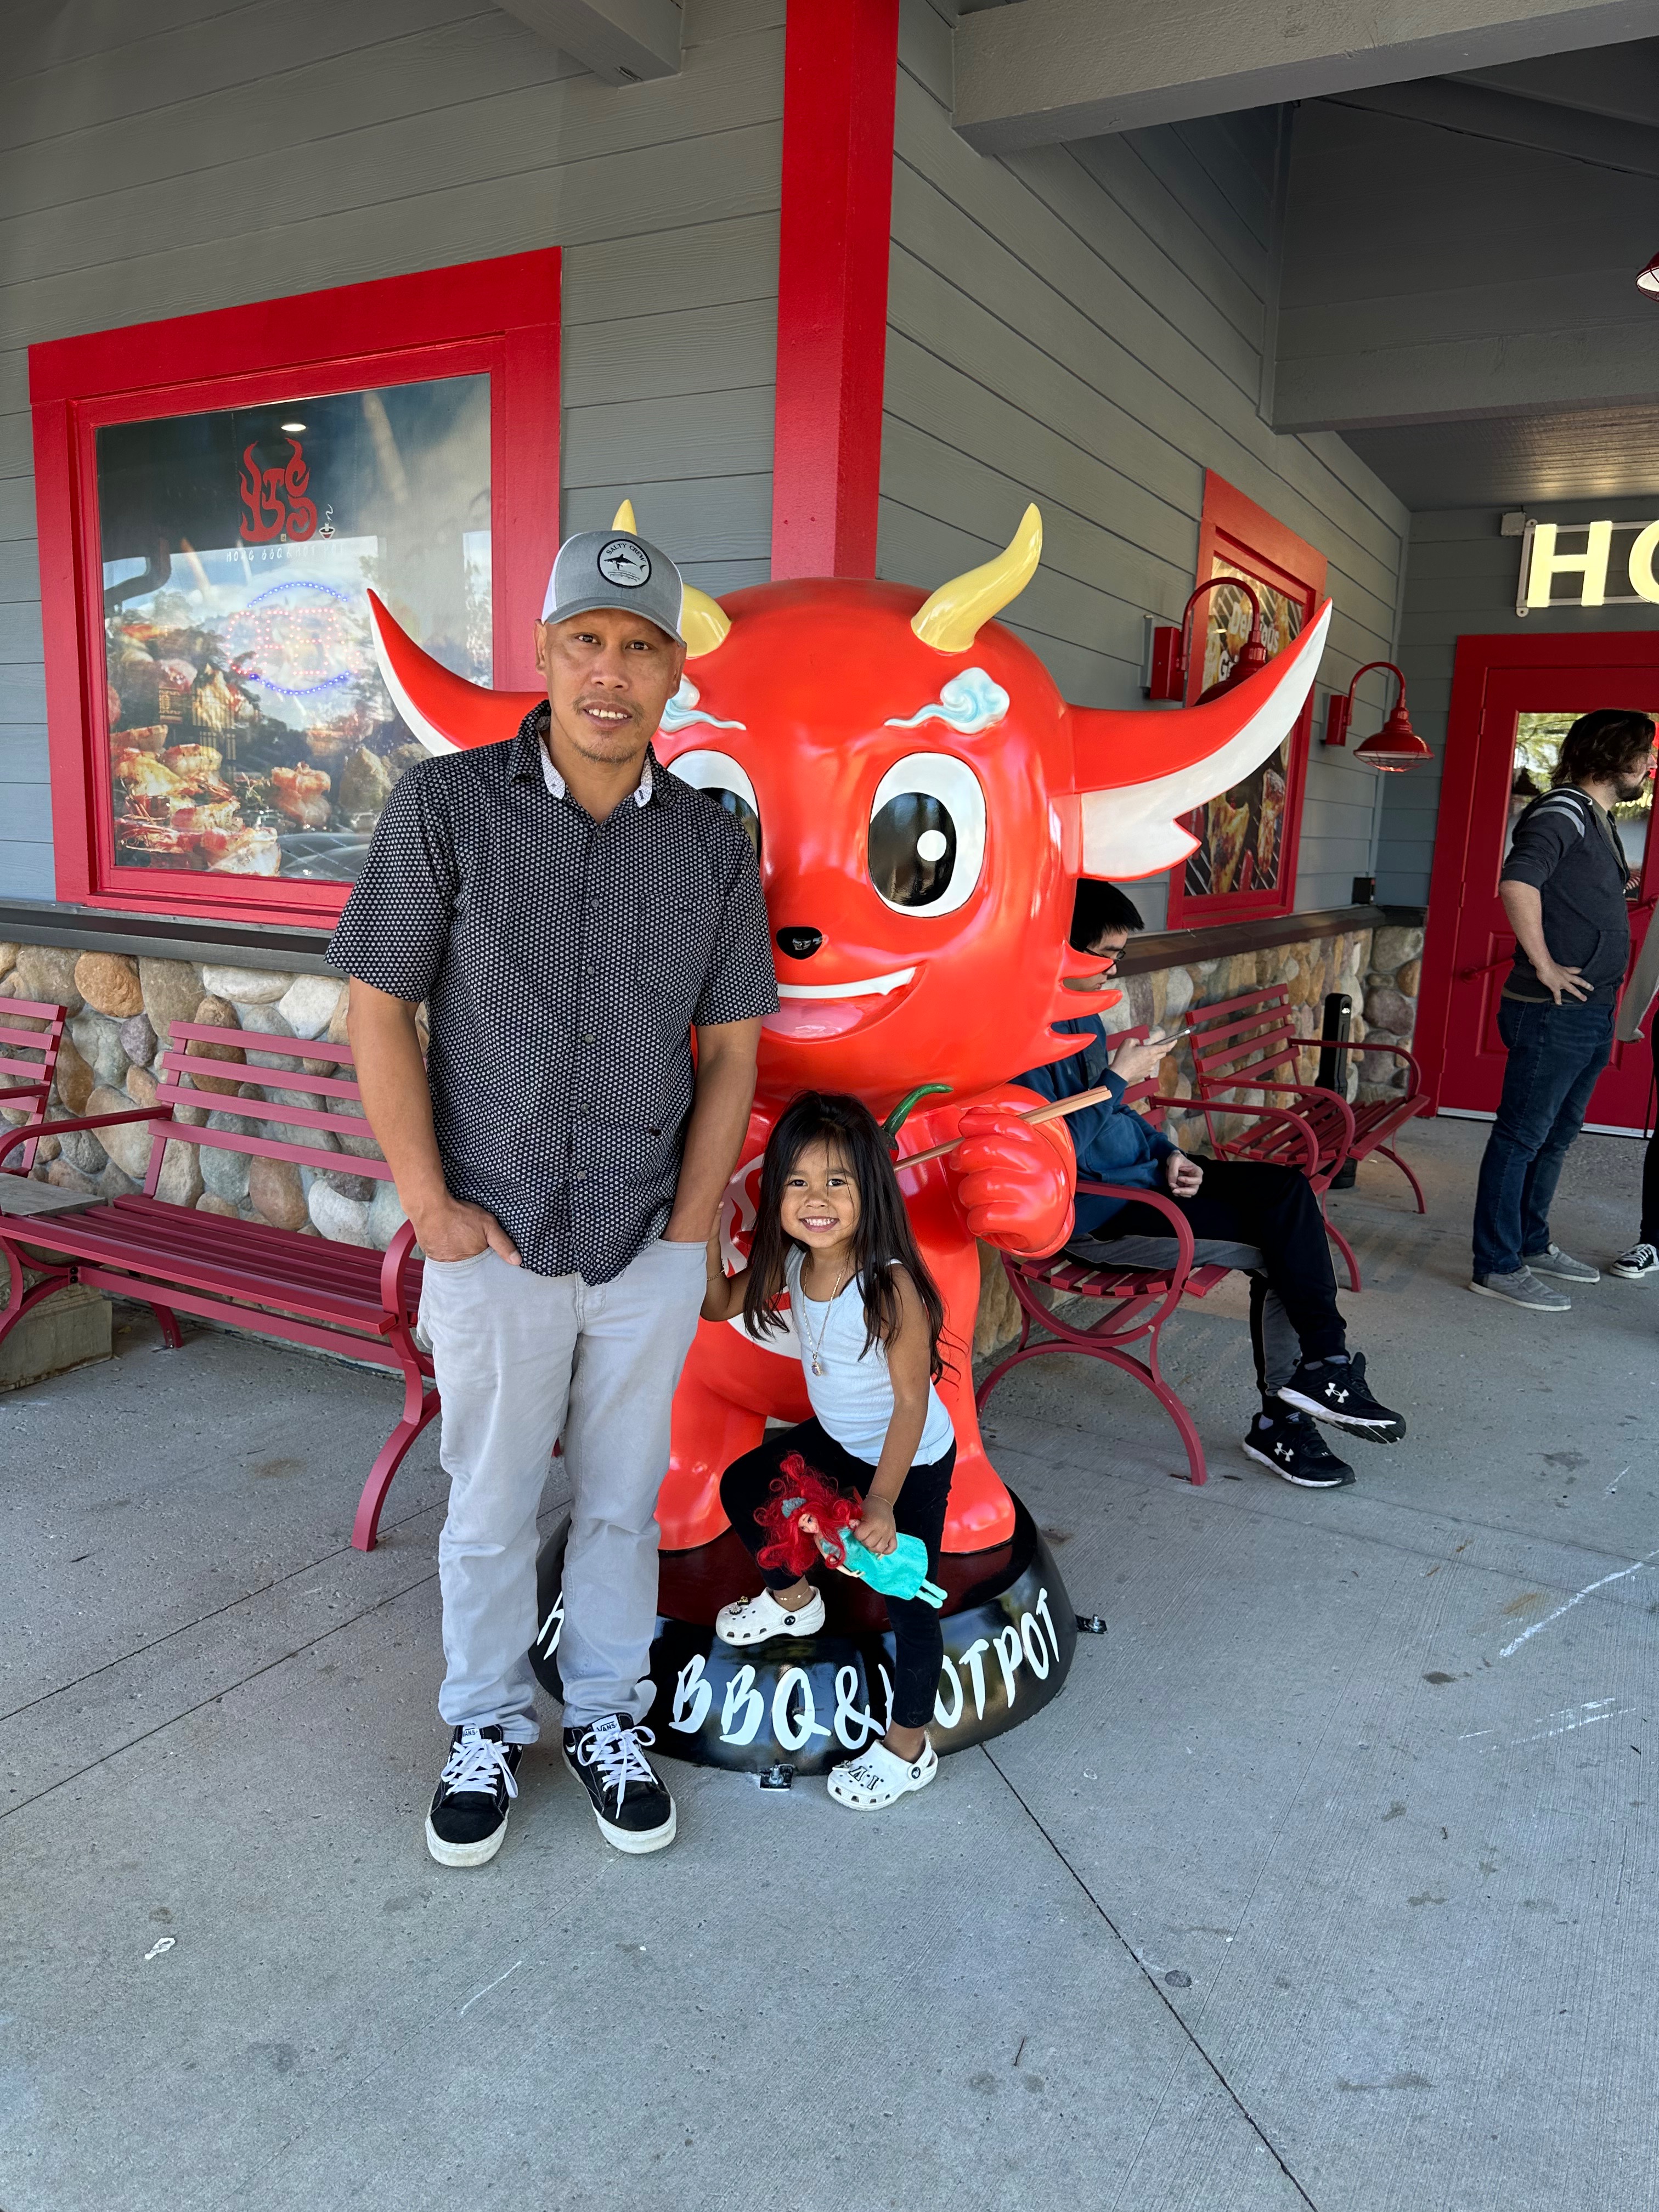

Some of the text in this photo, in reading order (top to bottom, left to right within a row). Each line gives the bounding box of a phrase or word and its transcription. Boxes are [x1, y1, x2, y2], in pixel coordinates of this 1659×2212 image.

[606, 543, 646, 562] SALTY CREW
[225, 607, 360, 675] OPEN
[462, 1728, 476, 1737] VANS
[596, 1720, 615, 1731] VANS
